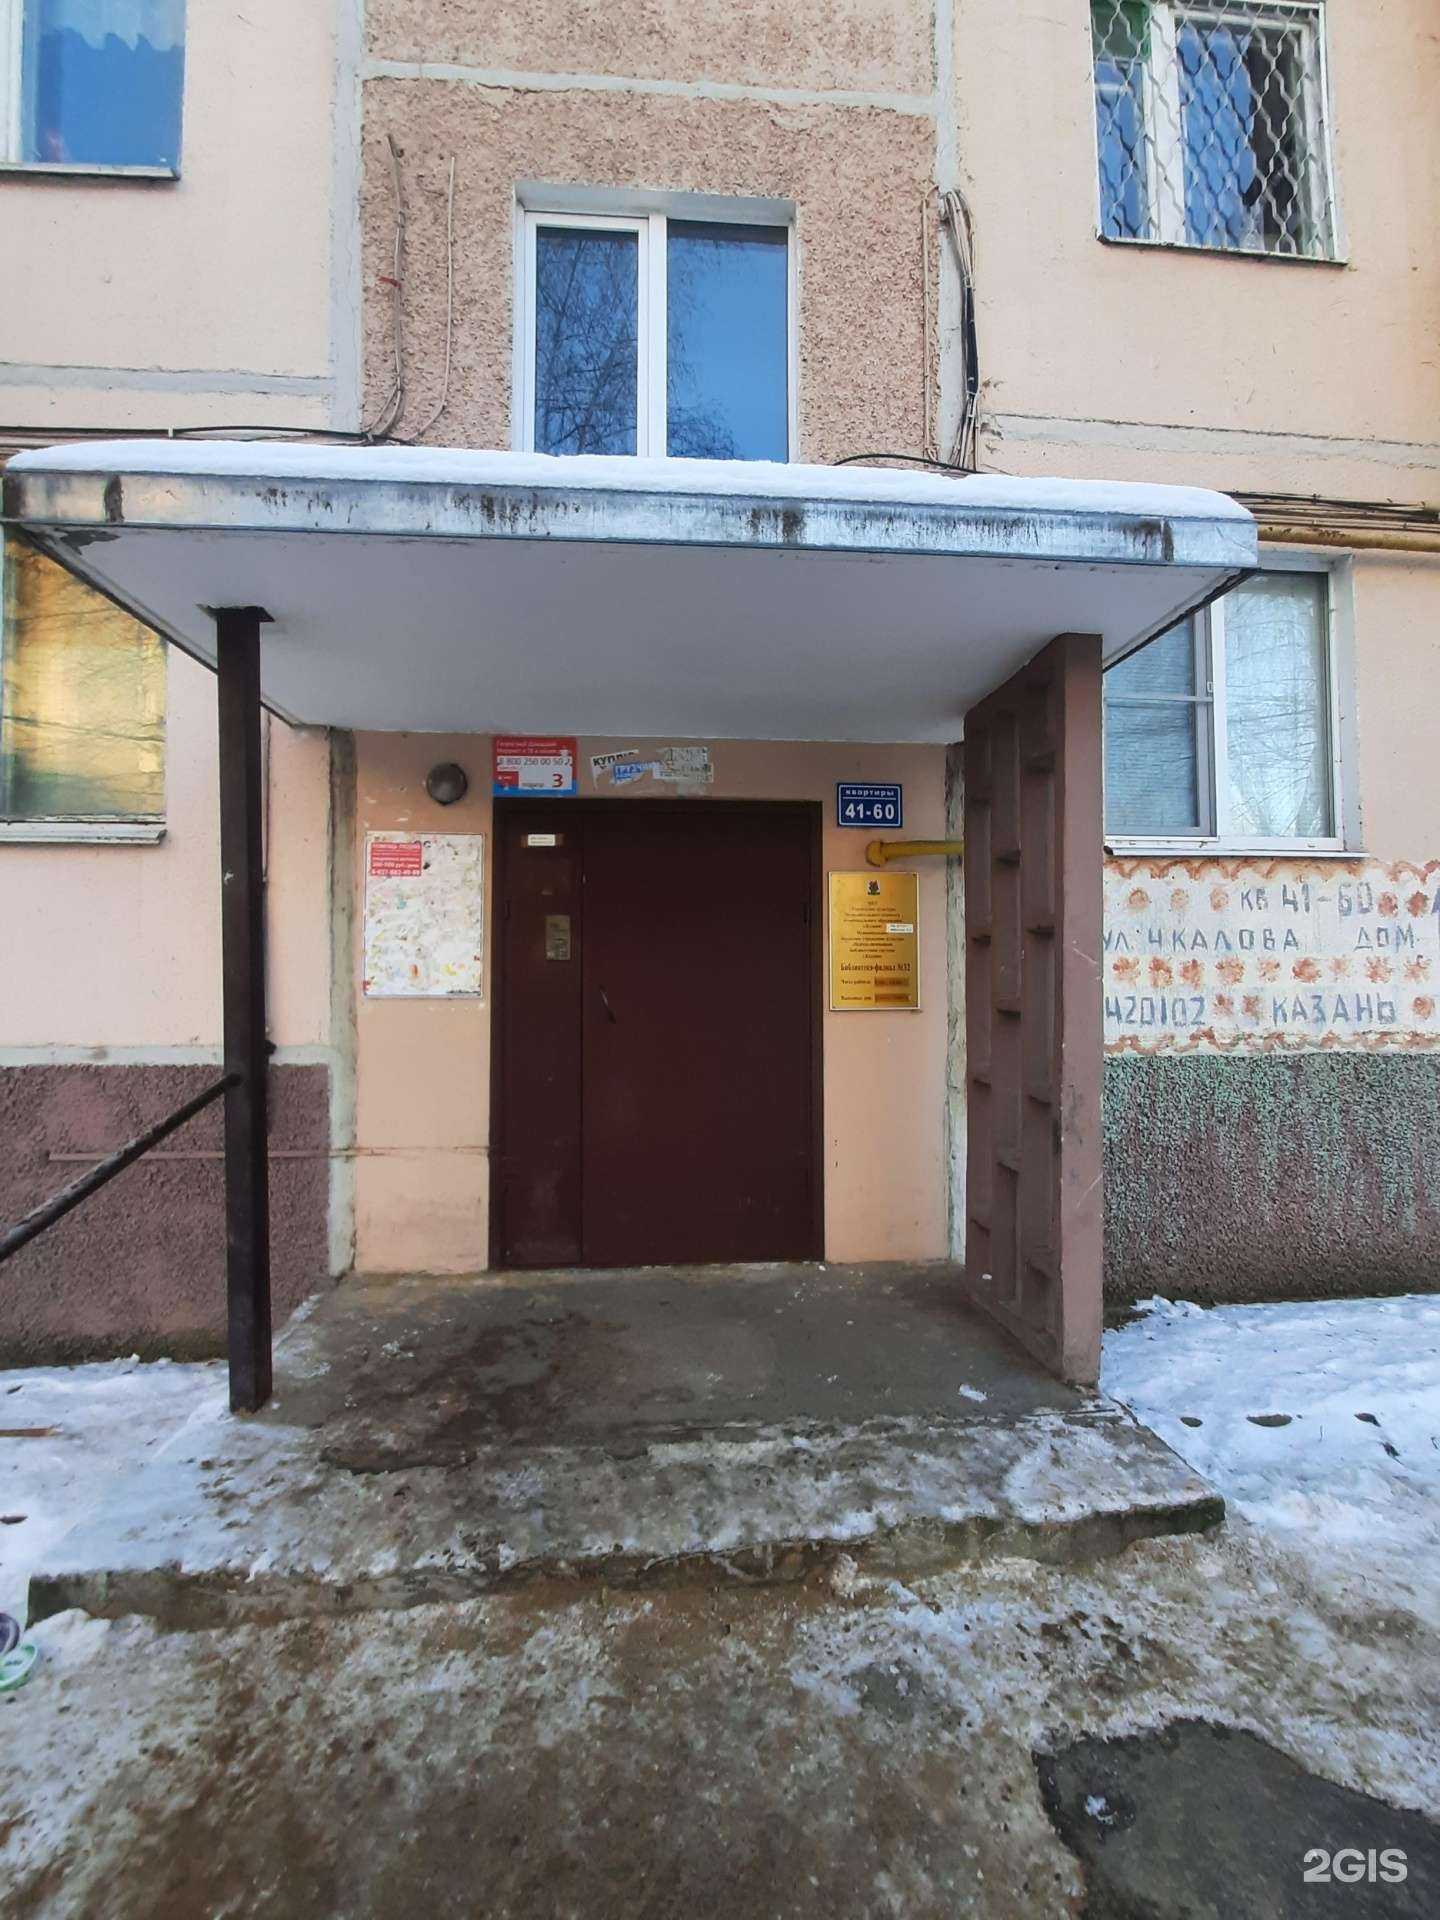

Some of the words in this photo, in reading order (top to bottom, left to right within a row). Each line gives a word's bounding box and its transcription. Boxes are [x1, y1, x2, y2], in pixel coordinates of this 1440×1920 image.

[506, 757, 521, 766] 800
[523, 757, 539, 766] 250
[552, 773, 563, 787] 3
[845, 789, 895, 797] квартиры
[844, 803, 895, 820] 41-60
[1148, 927, 1299, 952] ЧКАЛОВА
[1105, 995, 1206, 1026] 420102
[1272, 994, 1395, 1026] КАЗАНЬ
